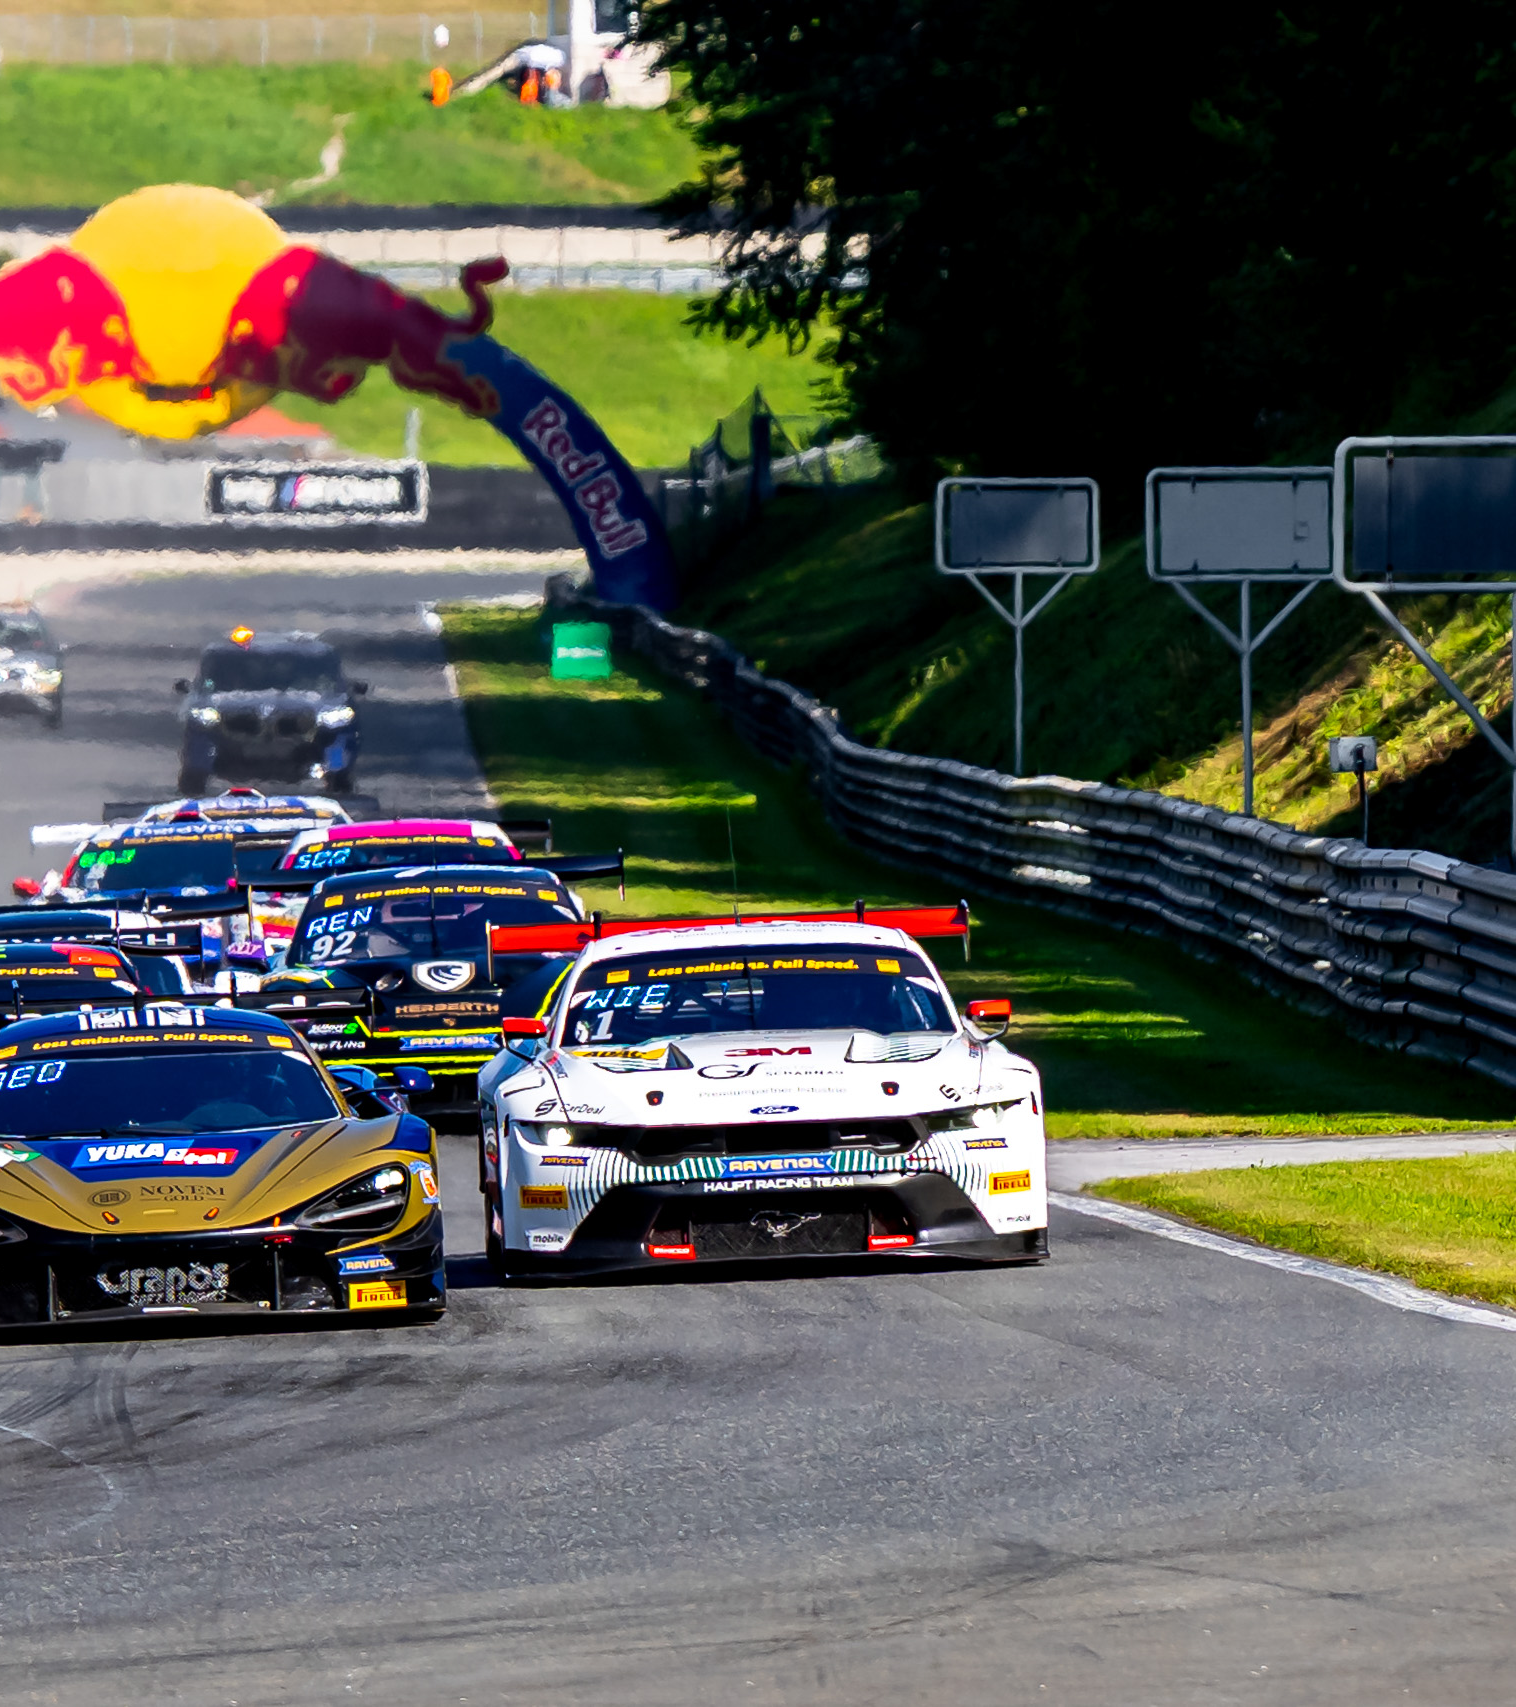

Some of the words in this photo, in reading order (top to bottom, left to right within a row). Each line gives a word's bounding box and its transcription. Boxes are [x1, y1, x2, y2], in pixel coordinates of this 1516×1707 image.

[521, 396, 606, 487] Red
[575, 469, 647, 559] Bull
[306, 906, 373, 938] REN
[310, 931, 356, 961] 92
[648, 967, 683, 977] Less
[773, 960, 803, 970] Full
[806, 960, 859, 970] Speed.
[395, 1002, 499, 1014] HERBERTH
[591, 1010, 615, 1041] 1
[33, 1039, 68, 1050] Less
[70, 1035, 159, 1047] emissions.
[163, 1033, 196, 1042] Full
[198, 1034, 253, 1043] Speed.
[724, 1046, 812, 1056] 3M
[87, 1143, 164, 1162] YUKA
[729, 1158, 824, 1171] RAVENOL
[140, 1184, 225, 1196] NOVEM
[703, 1180, 752, 1193] HAUPT
[755, 1178, 812, 1190] RACING
[813, 1176, 854, 1187] TEAM
[533, 1234, 564, 1243] mobile
